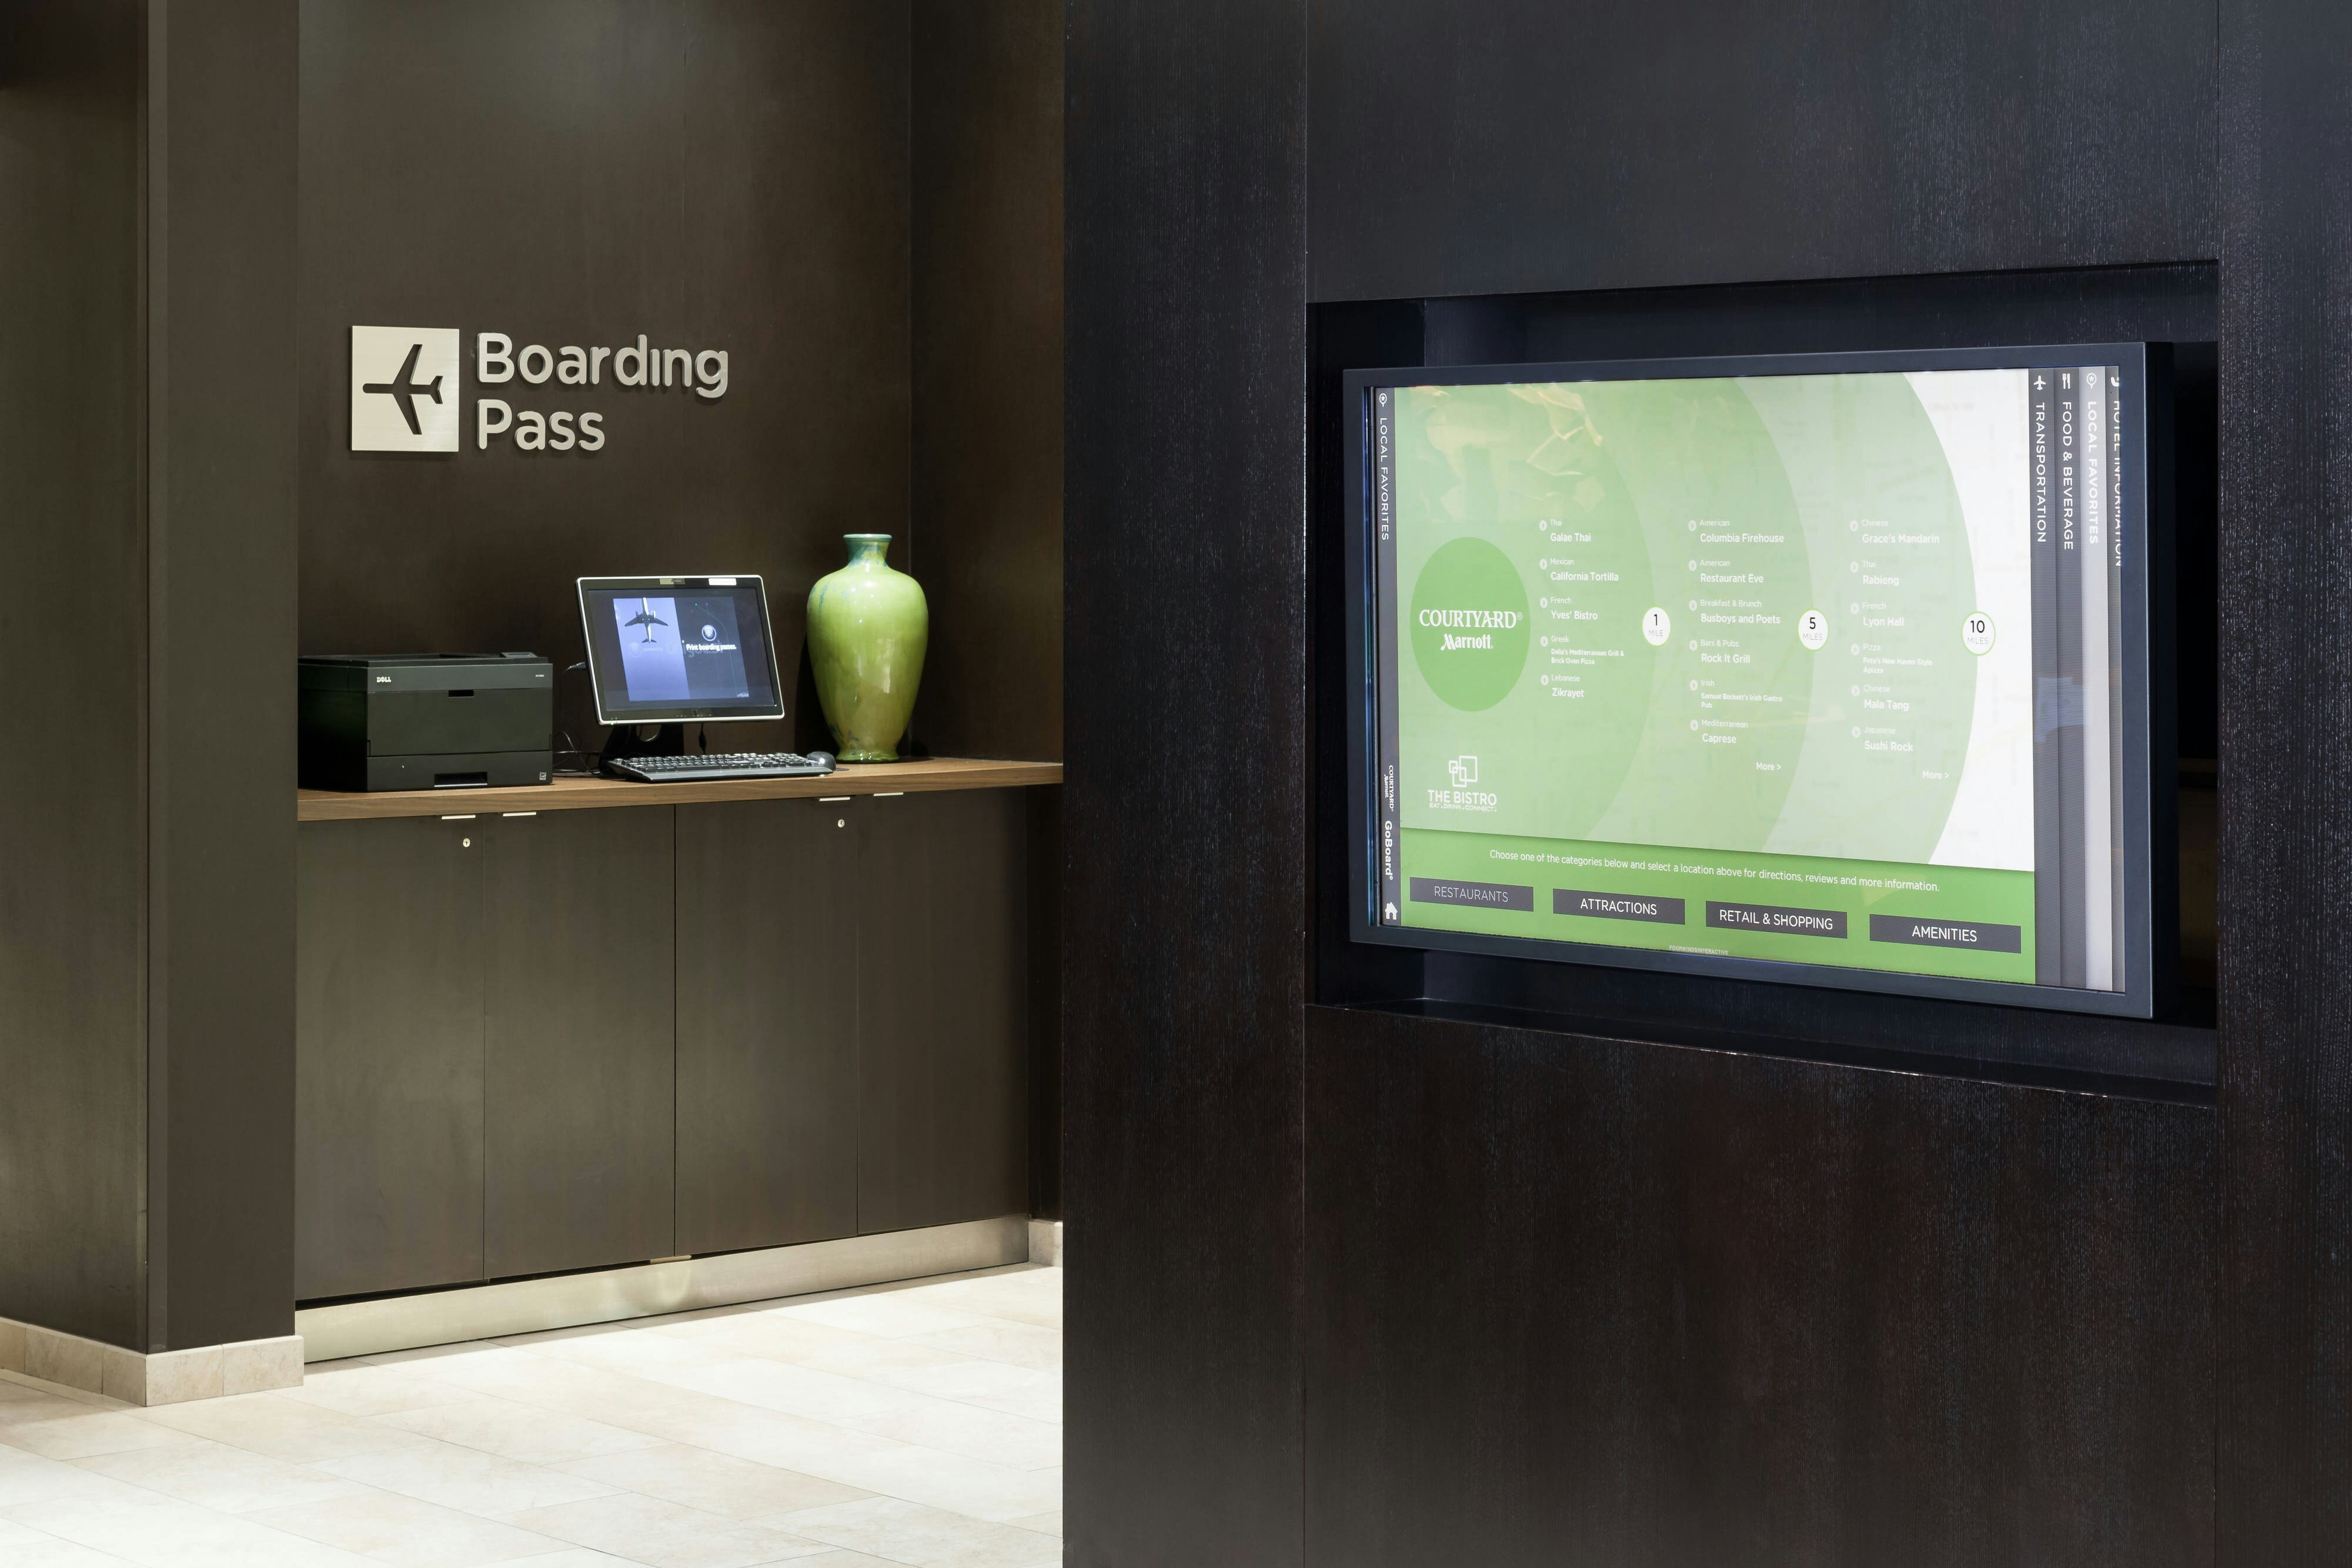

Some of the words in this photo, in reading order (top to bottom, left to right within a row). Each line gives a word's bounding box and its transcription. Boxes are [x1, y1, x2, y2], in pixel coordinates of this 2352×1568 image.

[477, 332, 729, 398] Boarding
[477, 399, 605, 451] Pass
[2062, 402, 2072, 446] FOOD
[2088, 401, 2097, 453] LOCAL
[2063, 451, 2073, 462] &
[2036, 402, 2046, 542] TRANSPORTATION
[1381, 467, 1389, 540] FAVORITES
[2088, 459, 2099, 544] FAVORITES
[2063, 467, 2073, 550] BEVERAGE
[1551, 533, 1572, 541] Galae
[1575, 533, 1591, 541] Thai
[1700, 533, 1740, 543] Columbia
[1742, 533, 1785, 543] Firehouse
[1862, 534, 1896, 544] Grace's
[1899, 534, 1939, 544] Mandarin
[1551, 571, 1588, 581] California
[1590, 571, 1619, 581] Tortilla
[1700, 573, 1746, 583] Restaurant
[1748, 574, 1764, 583] Eve
[1863, 575, 1899, 587] Rabieng
[1551, 610, 1572, 619] Yves'
[1574, 611, 1598, 620] Bistro
[1653, 614, 1658, 626] 1
[1701, 613, 1736, 624] Busboys
[1738, 614, 1753, 623] and
[1756, 614, 1780, 624] Poets
[1809, 617, 1816, 630] 5
[1863, 616, 1885, 627] Lyon
[1887, 617, 1905, 626] Hall
[1970, 620, 1985, 633] 10
[1967, 637, 1989, 645] MILES
[1701, 653, 1722, 662] Rock
[1724, 654, 1730, 663] It
[1733, 654, 1750, 663] Grill
[1552, 687, 1585, 698] Zikrayet
[1863, 684, 1890, 693] Chinese
[1864, 699, 1884, 709] Mala
[1887, 700, 1909, 711] Tang
[1701, 720, 1748, 728] Mediterranean
[1865, 727, 1896, 735] Japanese
[1702, 733, 1736, 744] Caprese
[1865, 740, 1888, 750] Sushi
[1890, 741, 1913, 752] Rock
[1756, 762, 1775, 771] More
[1923, 770, 1942, 779] More
[1428, 790, 1450, 803] THE
[1454, 791, 1497, 805] BISTRO
[1490, 850, 1518, 861] Choose
[1520, 852, 1535, 861] one
[1536, 852, 1545, 862] of
[1547, 854, 1559, 863] the
[1561, 855, 1602, 867] categories
[1604, 858, 1628, 869] below
[1630, 859, 1645, 870] and
[1648, 861, 1671, 871] select
[1681, 863, 1713, 875] location
[1716, 867, 1742, 877] above
[1744, 868, 1756, 877] for
[1759, 870, 1803, 882] directions,
[1806, 874, 1838, 884] reviews
[1840, 875, 1856, 885] and
[1859, 879, 1882, 887] more
[1885, 879, 1940, 892] information.
[1434, 886, 1508, 902] RESTAURANTS
[1581, 898, 1657, 915] ATTRACTIONS
[1720, 910, 1759, 924] RETAIL
[1763, 912, 1770, 925] &
[1773, 914, 1833, 930] SHOPPING
[1912, 925, 1977, 942] AMENITIES
